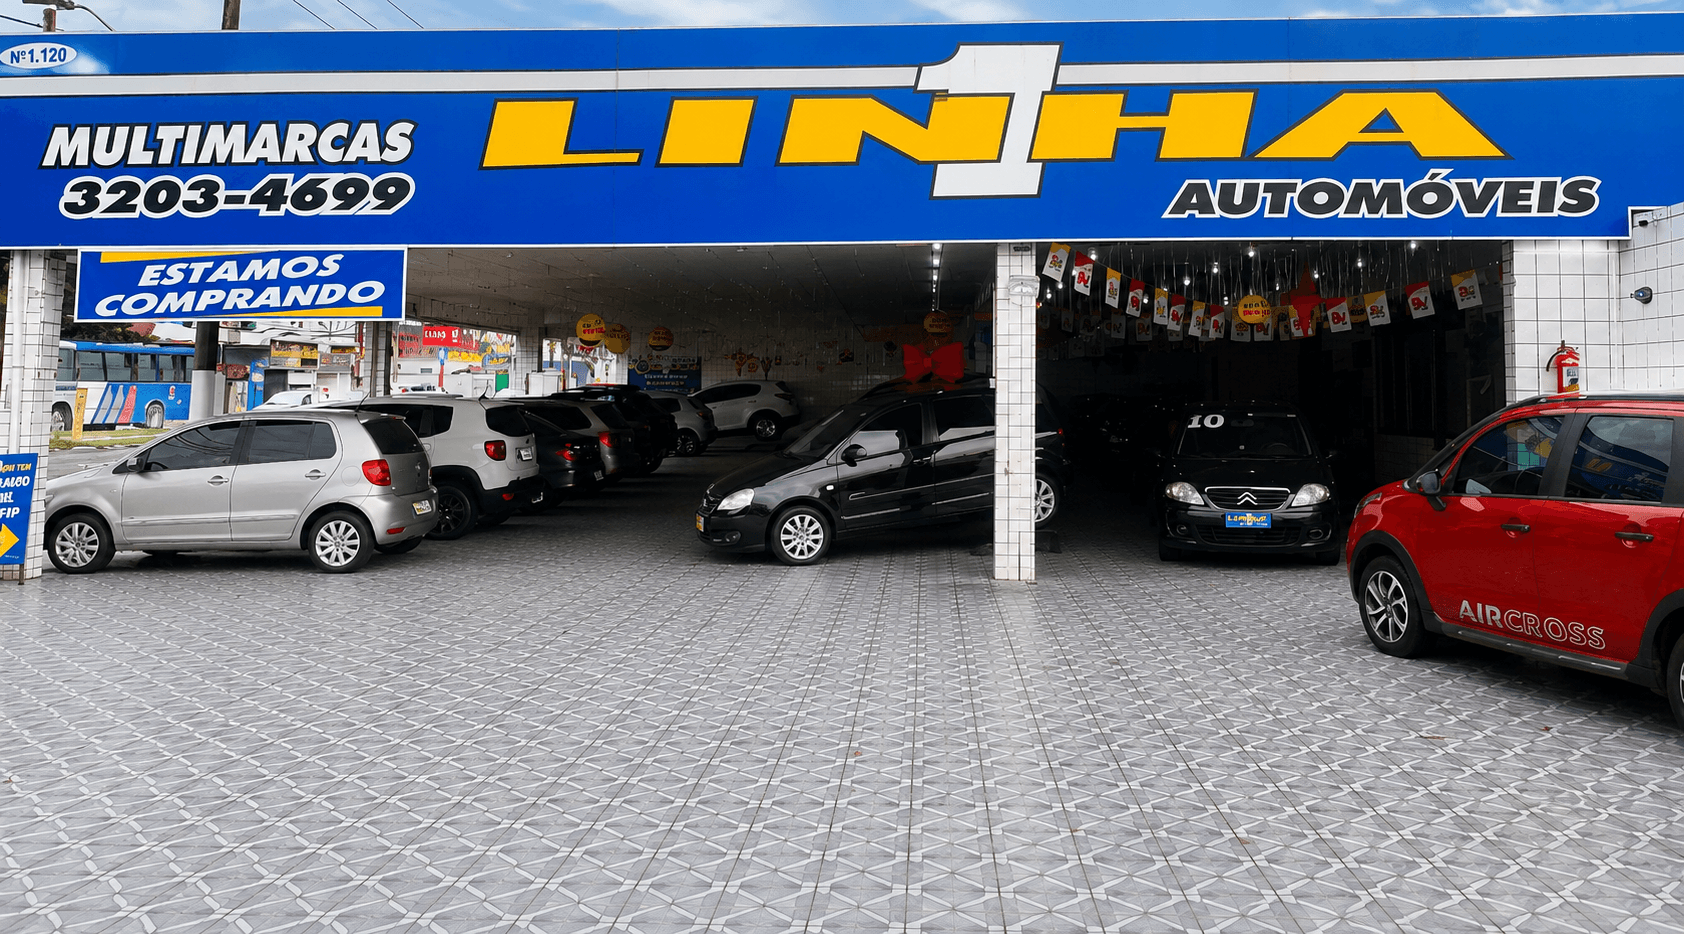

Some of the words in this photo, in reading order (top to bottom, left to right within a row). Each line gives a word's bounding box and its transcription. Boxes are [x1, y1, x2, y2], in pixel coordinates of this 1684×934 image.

[39, 118, 418, 170] MULTIMARCAS
[478, 88, 1515, 171] LINHA
[913, 42, 1064, 199] 1
[59, 172, 416, 219] 3203-4699
[1162, 168, 1602, 220] AUTOMÓVEIS
[137, 253, 344, 287] ESTAMOS
[94, 281, 385, 317] COMPRANDO
[1187, 414, 1225, 429] 10
[1459, 600, 1606, 650] AIRCROSS
